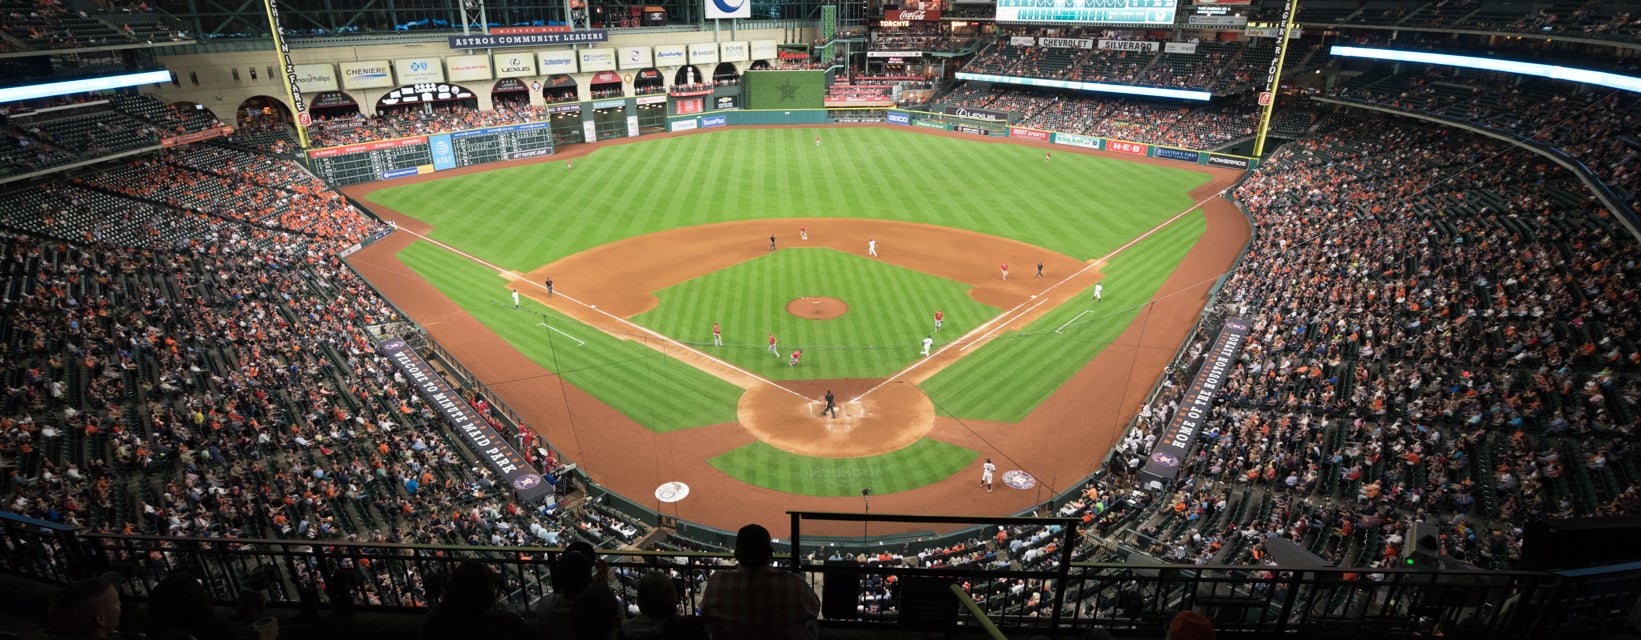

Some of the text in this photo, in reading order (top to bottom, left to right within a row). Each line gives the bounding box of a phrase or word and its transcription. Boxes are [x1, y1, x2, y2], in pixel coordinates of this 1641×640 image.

[498, 34, 560, 44] COMMUNITY
[563, 33, 603, 41] LEADERS
[1043, 38, 1088, 48] CHEVROLET
[345, 66, 386, 76] CHENIERE
[501, 65, 531, 73] LEXUS
[967, 111, 996, 120] LEXUS
[1209, 156, 1247, 167] POWERADE
[1172, 333, 1241, 449] HOME OF THE HOUSTON ASTROS
[394, 351, 518, 474] WELCOME TO MINUTE MAID PARK
